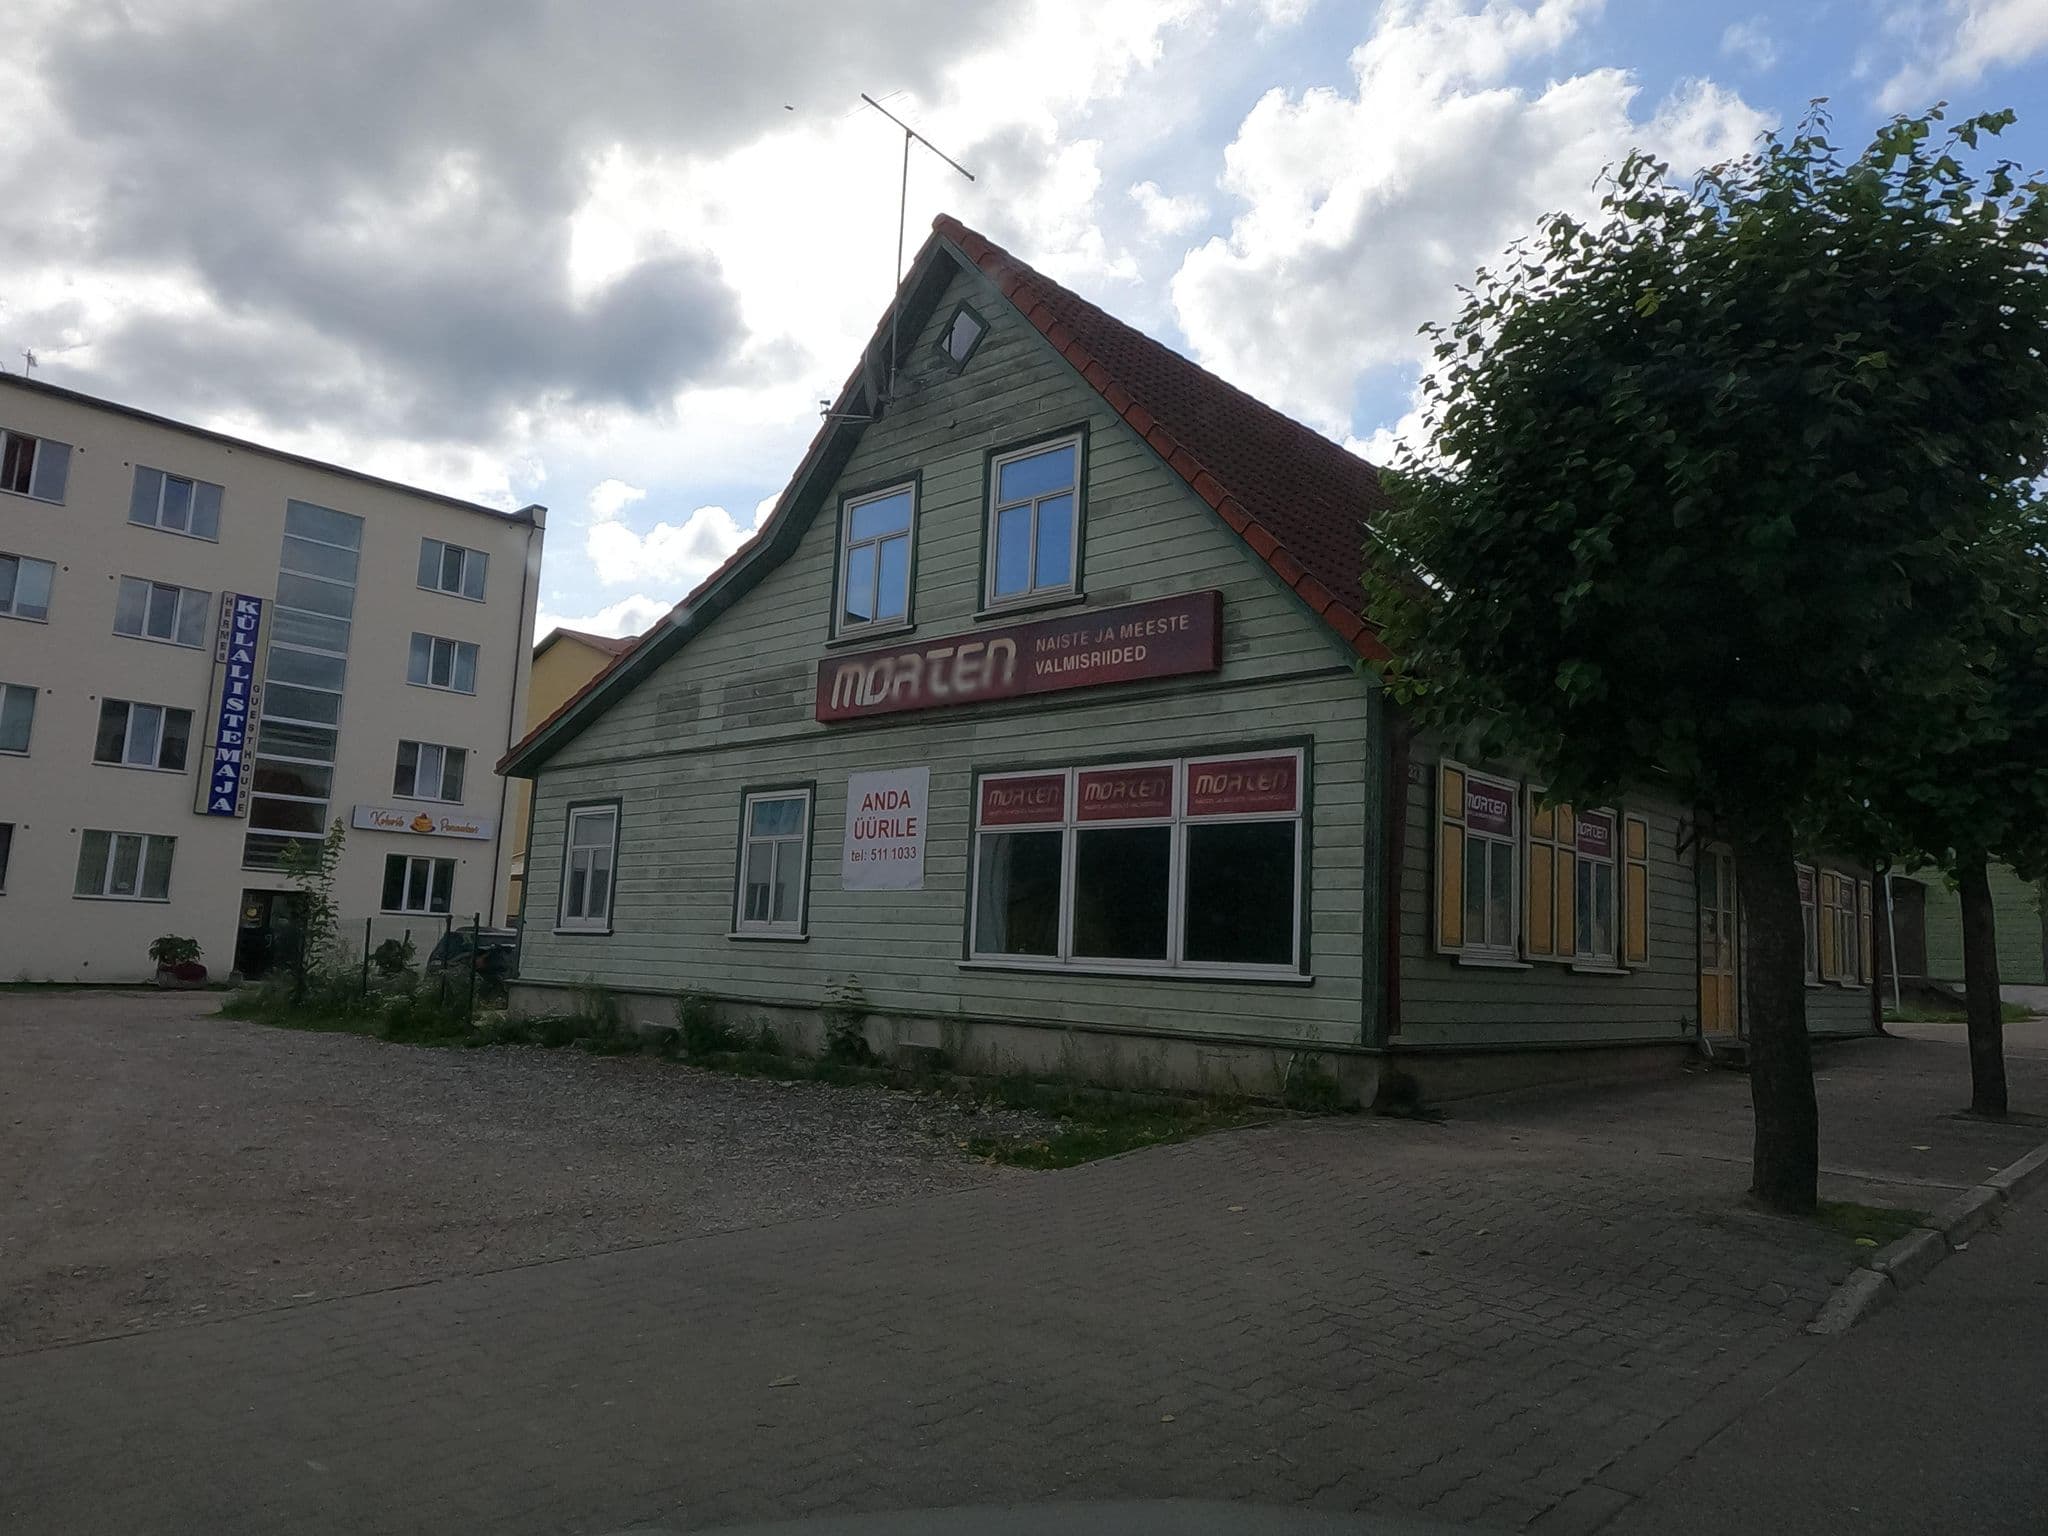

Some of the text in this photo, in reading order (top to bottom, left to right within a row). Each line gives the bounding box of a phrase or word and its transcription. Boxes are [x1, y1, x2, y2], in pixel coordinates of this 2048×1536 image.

[219, 598, 233, 661] HERMES
[1035, 614, 1191, 654] NAISTE JA MEESTE
[830, 637, 1018, 710] MORTEN
[1034, 645, 1148, 676] VALMISRIIDED
[211, 599, 259, 812] KÜLALISTEMAJA
[237, 685, 260, 812] GUESTHOUSE
[861, 790, 911, 812] ANDA
[854, 816, 917, 840] ÜÜRILE
[851, 846, 917, 862] tel: 511 1033
